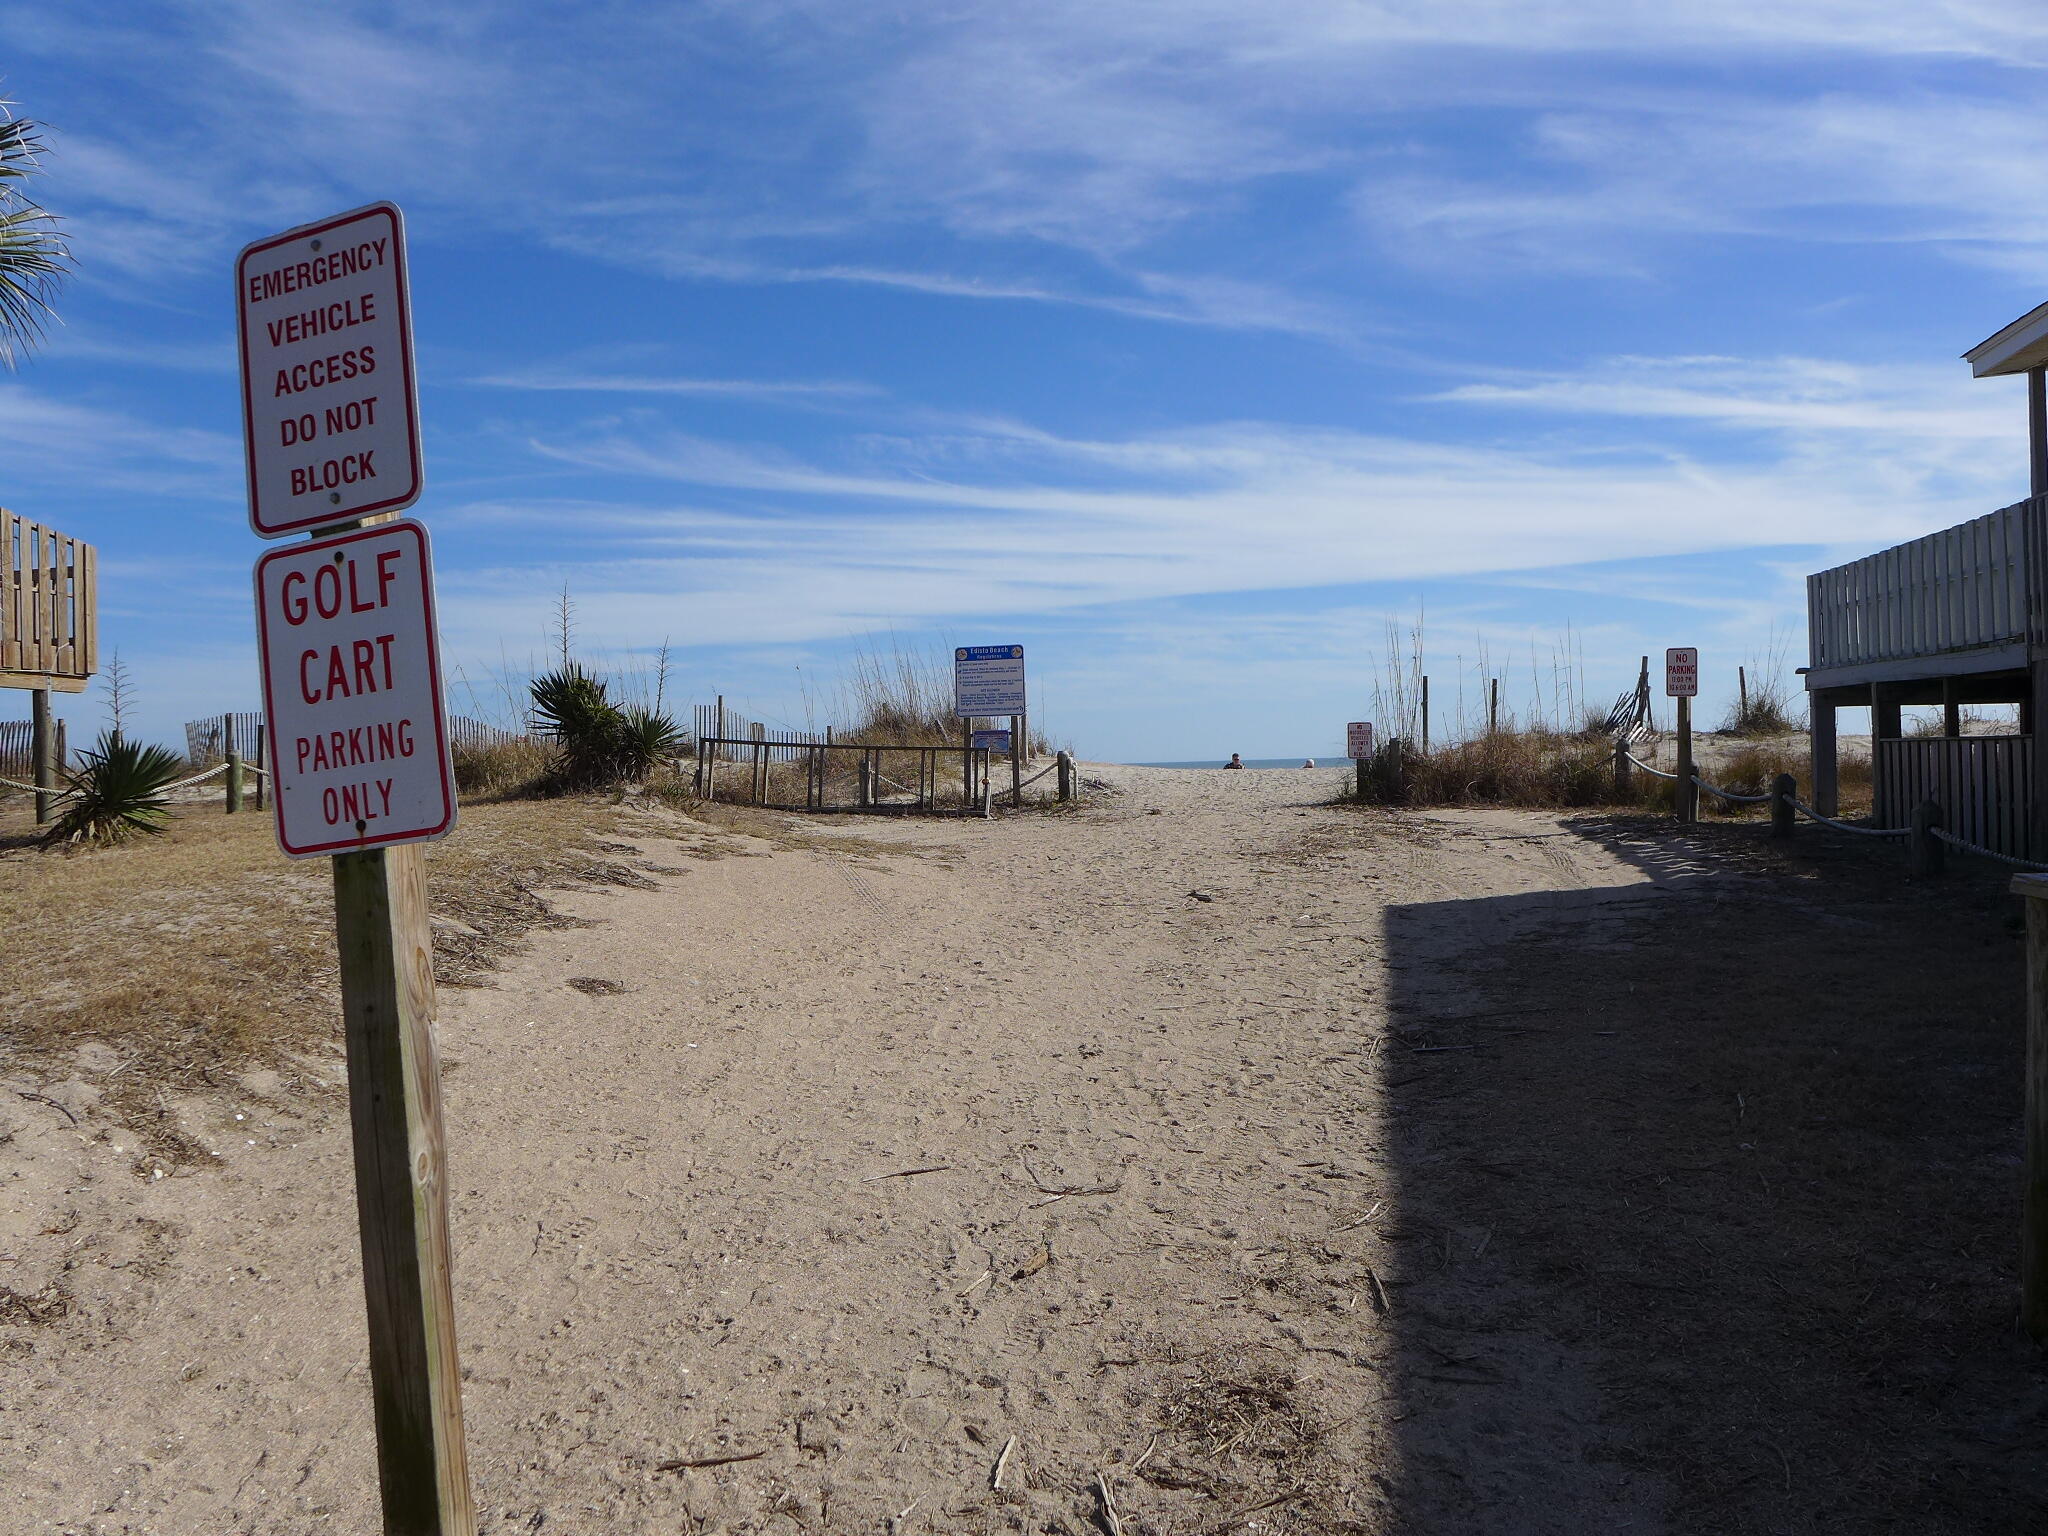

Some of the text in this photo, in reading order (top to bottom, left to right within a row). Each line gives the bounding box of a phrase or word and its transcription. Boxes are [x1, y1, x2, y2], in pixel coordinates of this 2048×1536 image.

[250, 238, 387, 303] EMERGENCY
[267, 294, 376, 347] VEHICLE
[274, 346, 376, 397] ACCESS
[281, 397, 378, 447] DO NOT
[291, 450, 376, 496] BLOCK
[282, 550, 401, 626] GOLF
[300, 634, 395, 704] CART
[1668, 664, 1696, 675] PARKING
[1675, 653, 1688, 663] NO
[296, 719, 415, 774] PARKING
[322, 778, 393, 825] ONLY
